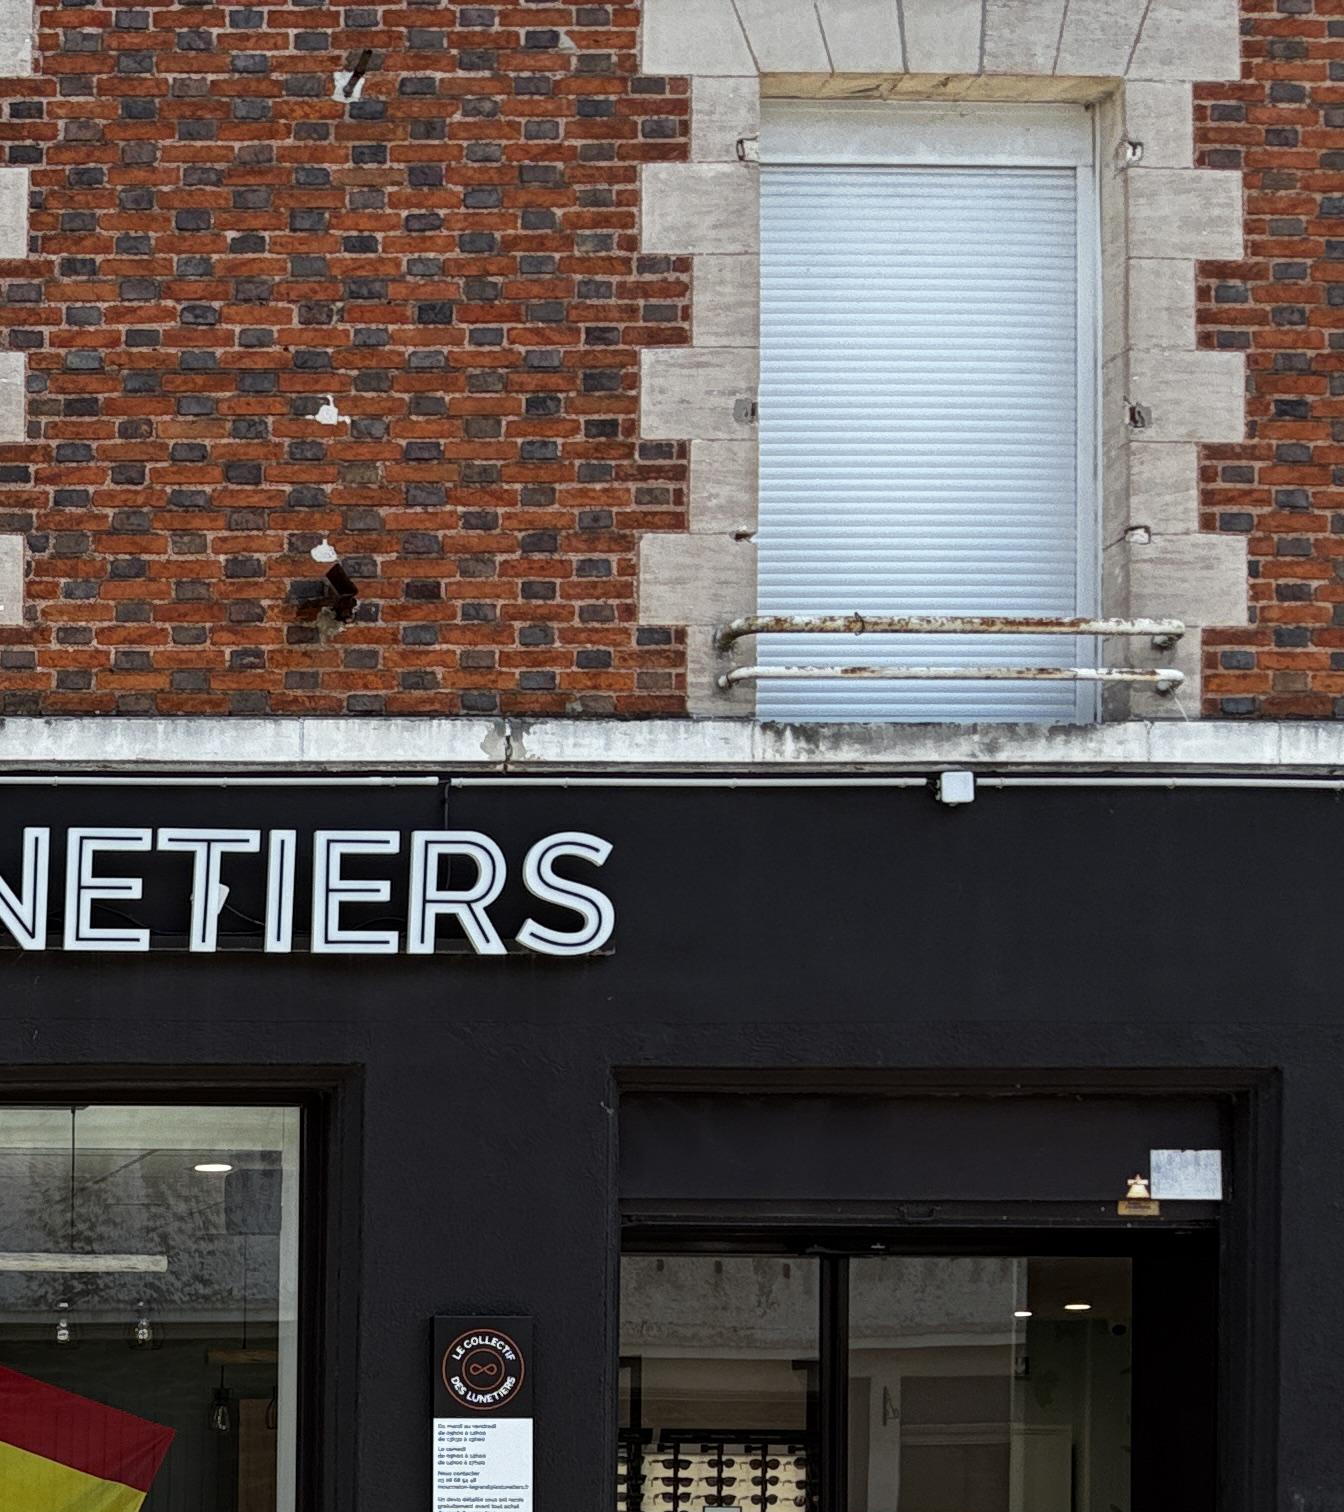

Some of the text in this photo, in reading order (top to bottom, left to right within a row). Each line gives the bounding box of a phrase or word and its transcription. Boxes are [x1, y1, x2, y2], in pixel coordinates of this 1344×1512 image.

[452, 1335, 516, 1361] LE COLLECTIF
[450, 1376, 516, 1404] DES LUNETIERS
